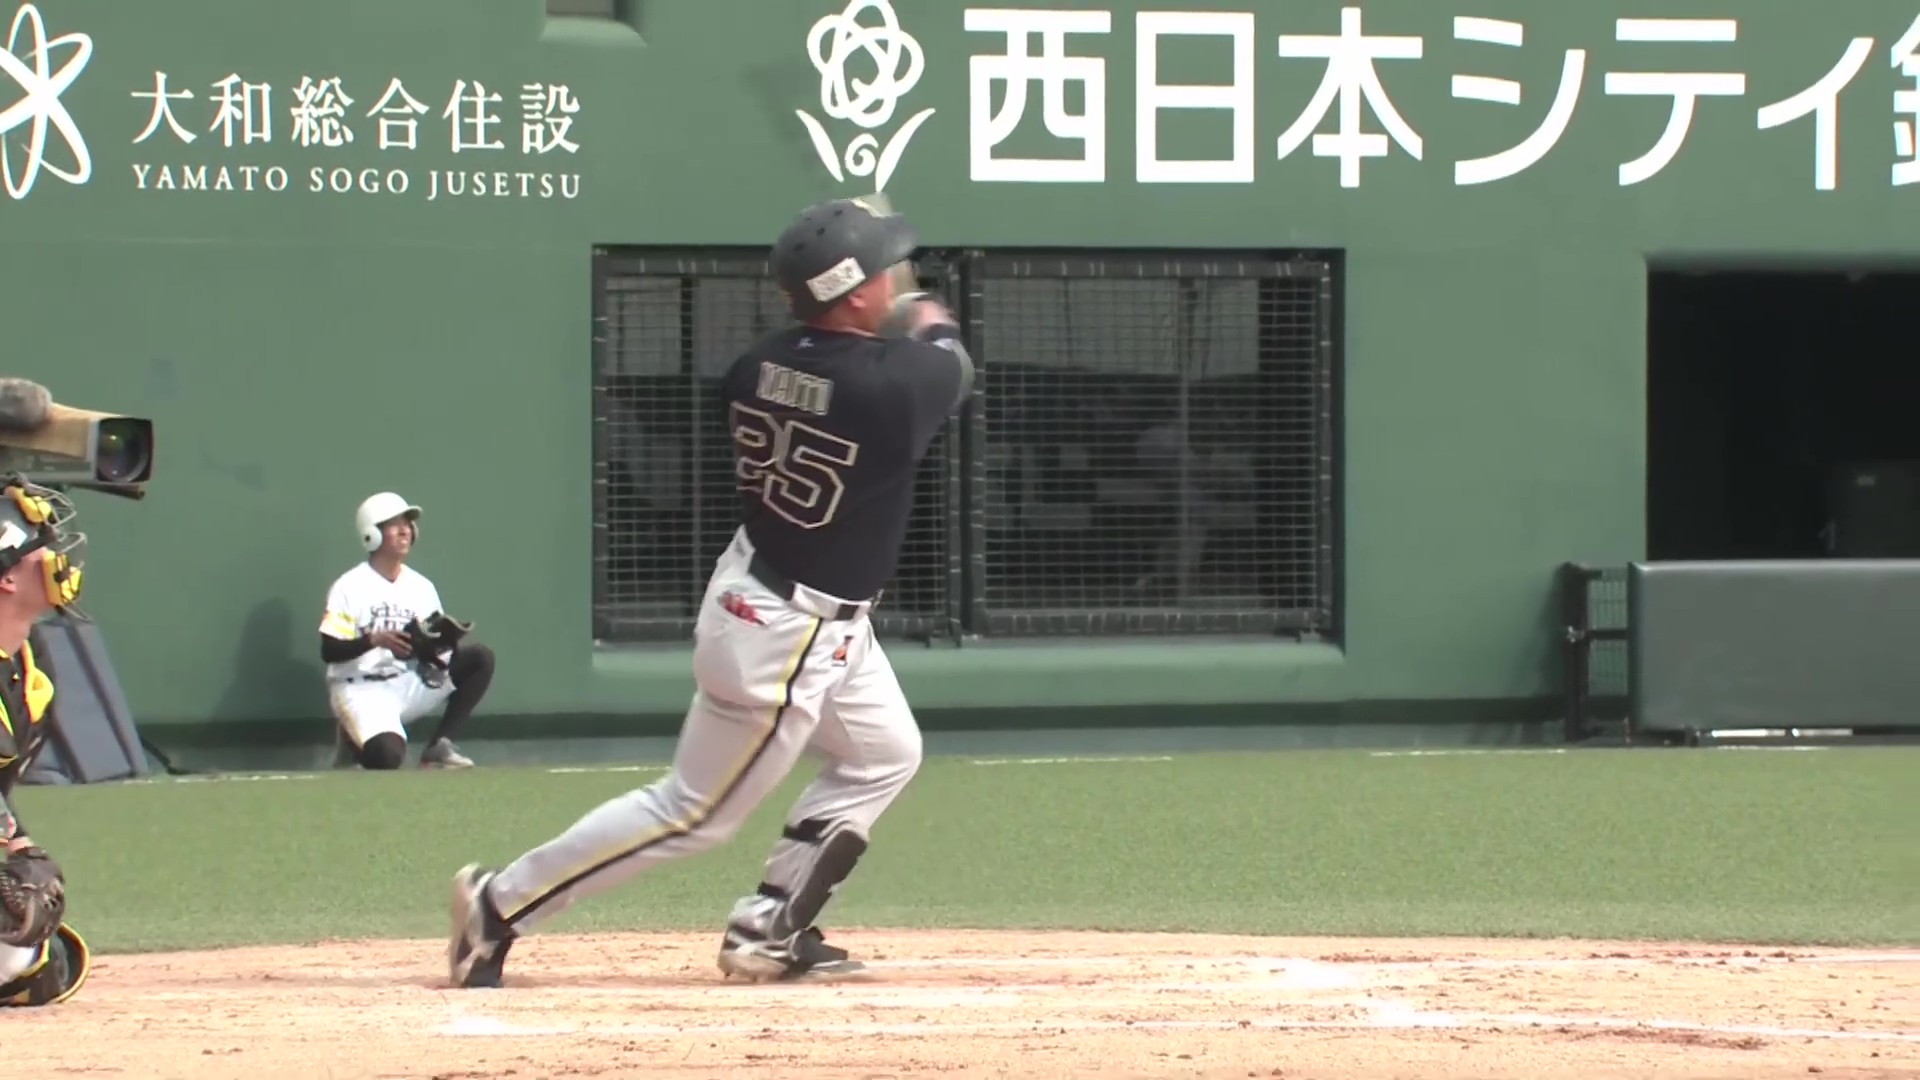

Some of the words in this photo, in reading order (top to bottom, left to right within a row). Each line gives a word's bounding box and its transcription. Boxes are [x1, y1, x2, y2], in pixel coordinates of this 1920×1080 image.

[130, 71, 581, 154] 大和総合住設
[965, 7, 1920, 190] 西日本シティ
[132, 163, 288, 191] YAMATO
[309, 166, 409, 194] SOGO
[426, 170, 581, 200] JUSETSU
[729, 401, 859, 528] 25
